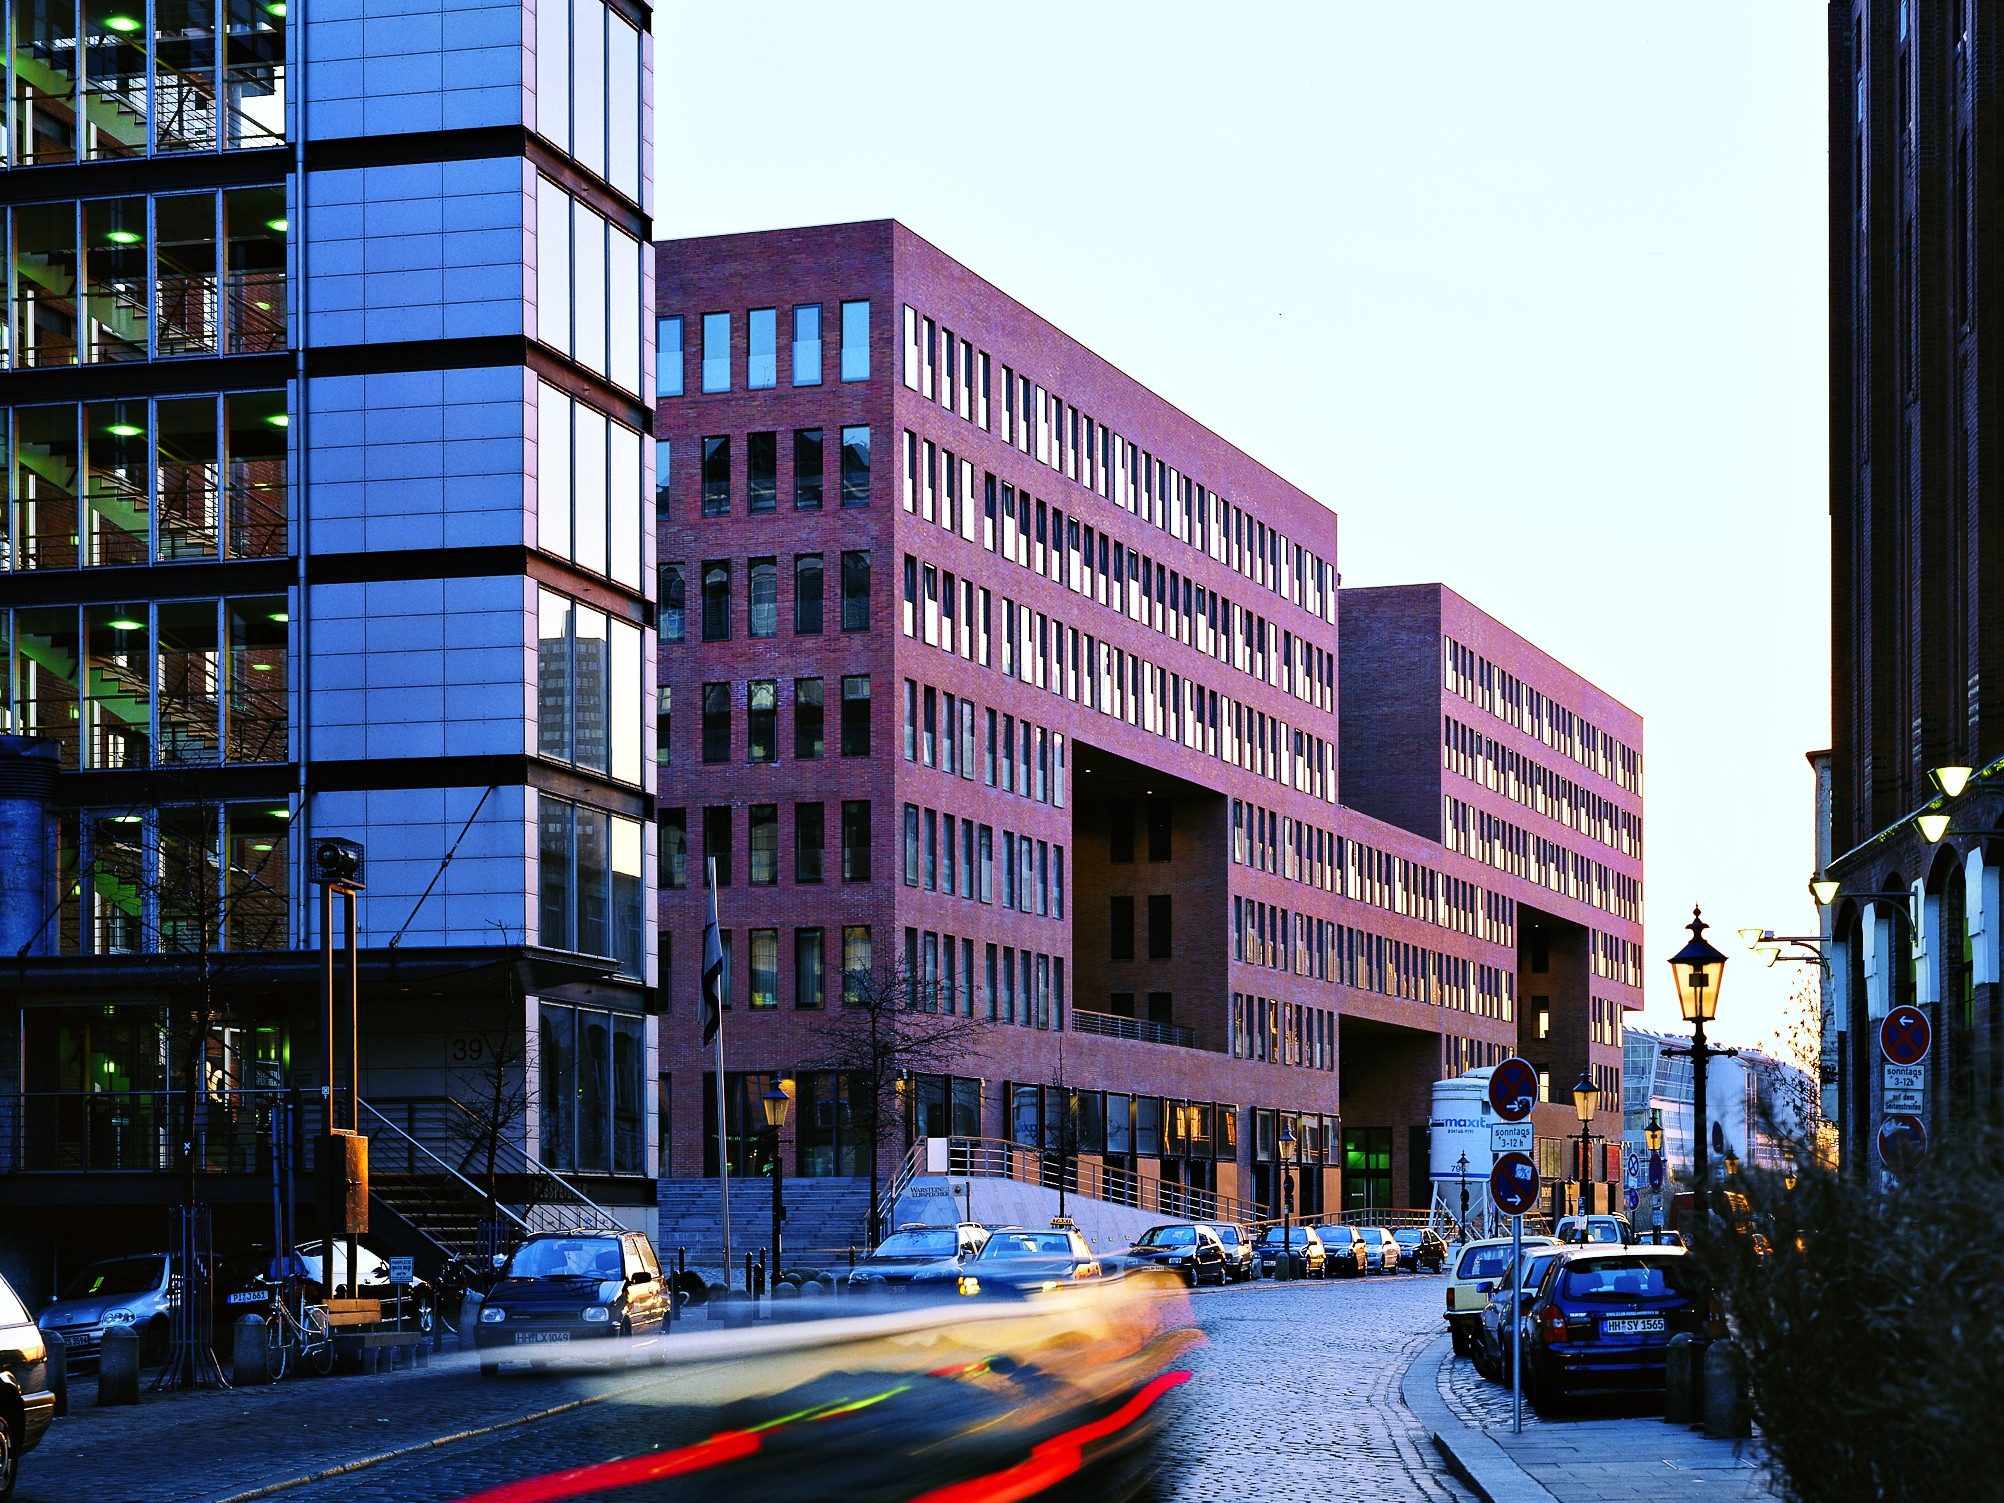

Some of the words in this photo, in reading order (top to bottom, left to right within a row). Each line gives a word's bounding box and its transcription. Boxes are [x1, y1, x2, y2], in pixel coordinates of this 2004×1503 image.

[452, 1038, 482, 1061] 39
[1886, 1067, 1922, 1079] sonntags
[1444, 1117, 1486, 1128] maxit
[1495, 1127, 1530, 1139] sonntags
[1501, 1138, 1518, 1147] 3-12
[1519, 1138, 1524, 1147] h
[252, 1291, 266, 1300] 661
[1608, 1320, 1621, 1332] HH
[1627, 1320, 1639, 1331] SY
[1640, 1319, 1664, 1331] 1565
[516, 1333, 531, 1343] HH
[535, 1333, 548, 1343] LX
[549, 1333, 569, 1343] 1049
